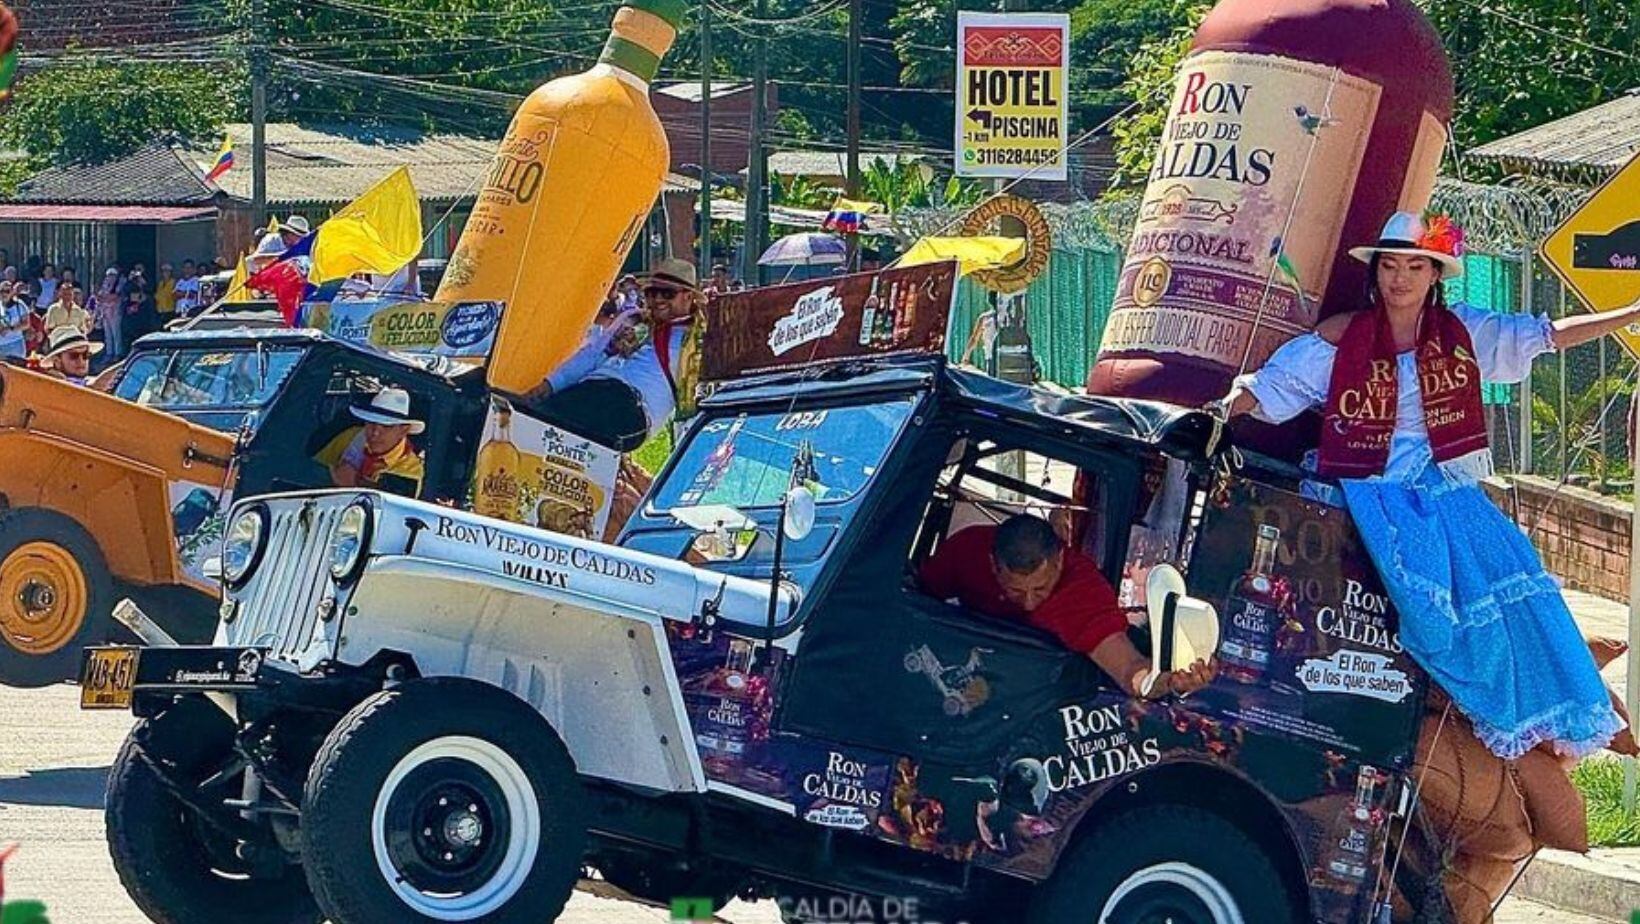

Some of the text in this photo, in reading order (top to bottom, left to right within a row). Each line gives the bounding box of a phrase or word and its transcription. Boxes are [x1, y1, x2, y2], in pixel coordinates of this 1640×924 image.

[969, 70, 1057, 107] HOTEL
[993, 117, 1059, 139] PISCINA
[1214, 122, 1242, 141] DE
[1152, 141, 1275, 187] ALDAS
[387, 311, 437, 331] COLOR
[385, 330, 440, 346] FELICIDAD
[1370, 359, 1396, 383] R
[543, 469, 589, 494] COLOR
[480, 524, 542, 558] VIEJO
[543, 546, 568, 566] DE
[570, 547, 657, 586] CALDAS
[1343, 578, 1389, 615] RON
[1316, 606, 1404, 653] CALDAS
[1339, 656, 1375, 673] El Ron
[1305, 668, 1405, 694] de los que saben
[1059, 704, 1123, 741] RON
[1066, 732, 1128, 758] VIEJO DE
[827, 751, 868, 777] RON
[1043, 737, 1162, 793] CALDAS
[803, 773, 882, 808] CALDAS
